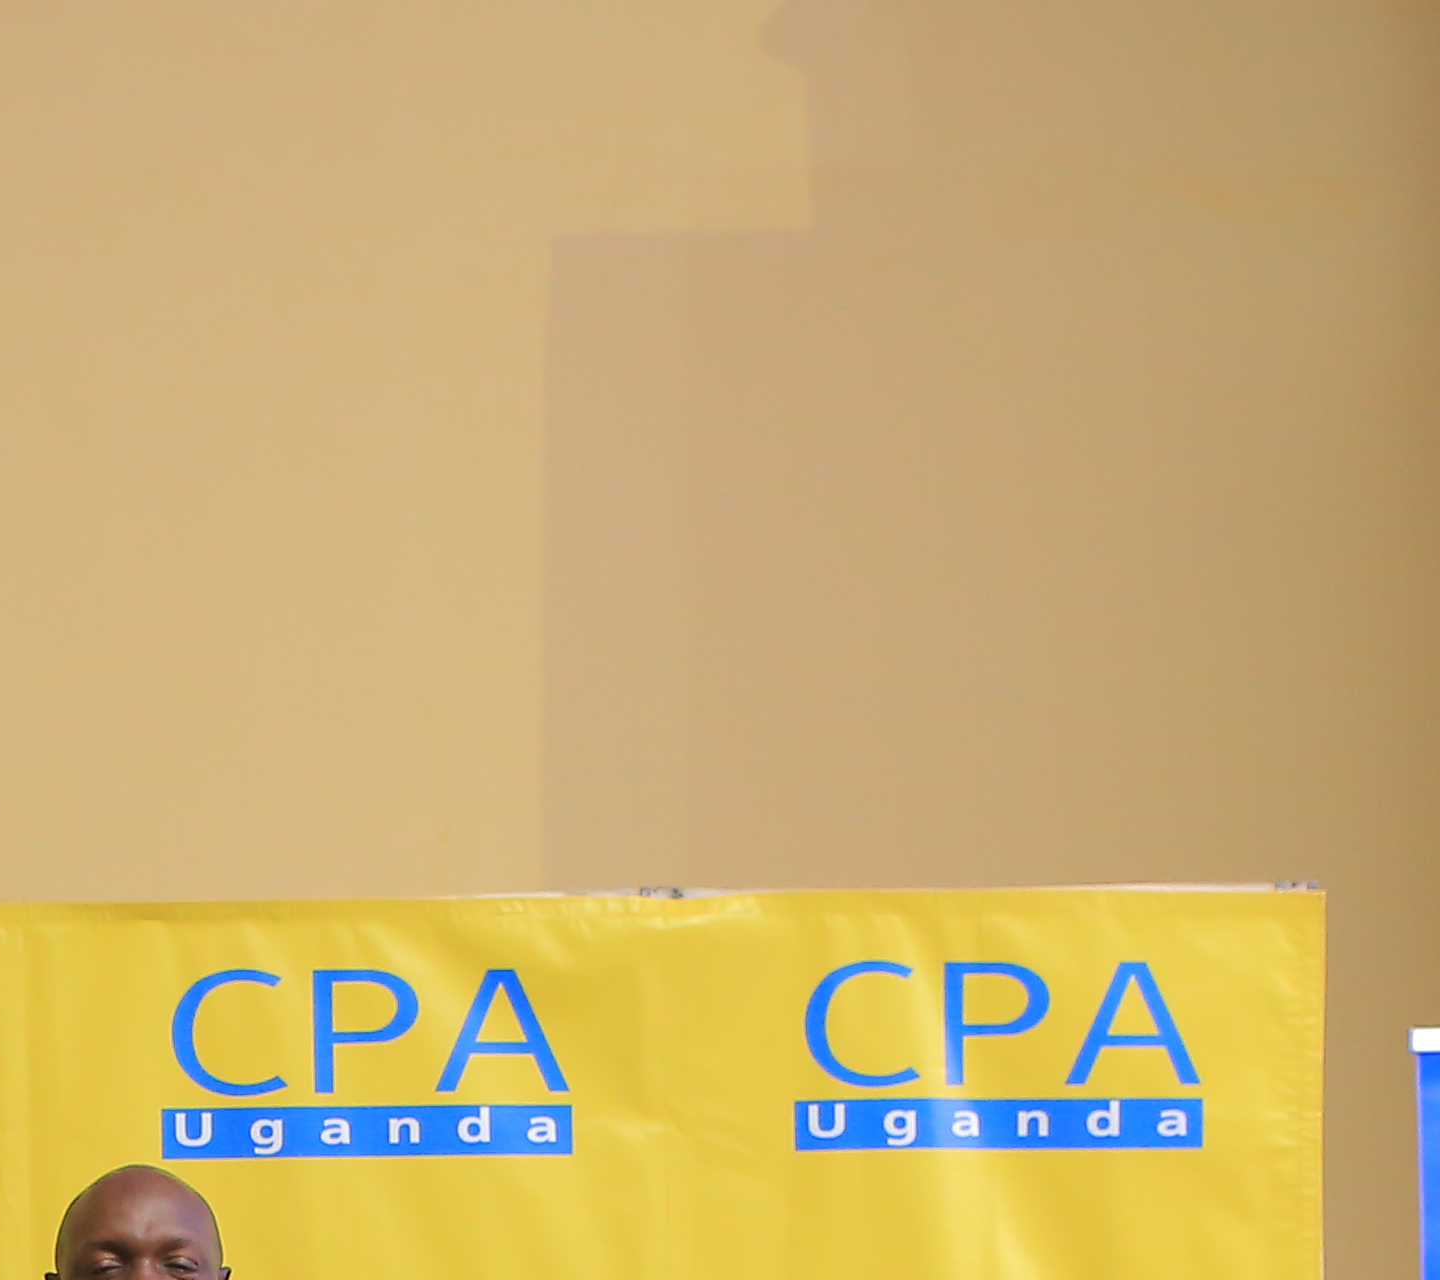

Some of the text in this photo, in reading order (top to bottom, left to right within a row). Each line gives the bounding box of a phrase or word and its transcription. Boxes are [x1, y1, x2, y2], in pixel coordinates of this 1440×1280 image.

[173, 969, 568, 1096] CPA
[806, 961, 1199, 1087] CPA
[174, 1107, 557, 1155] Uganda
[807, 1097, 1187, 1146] Uganda
